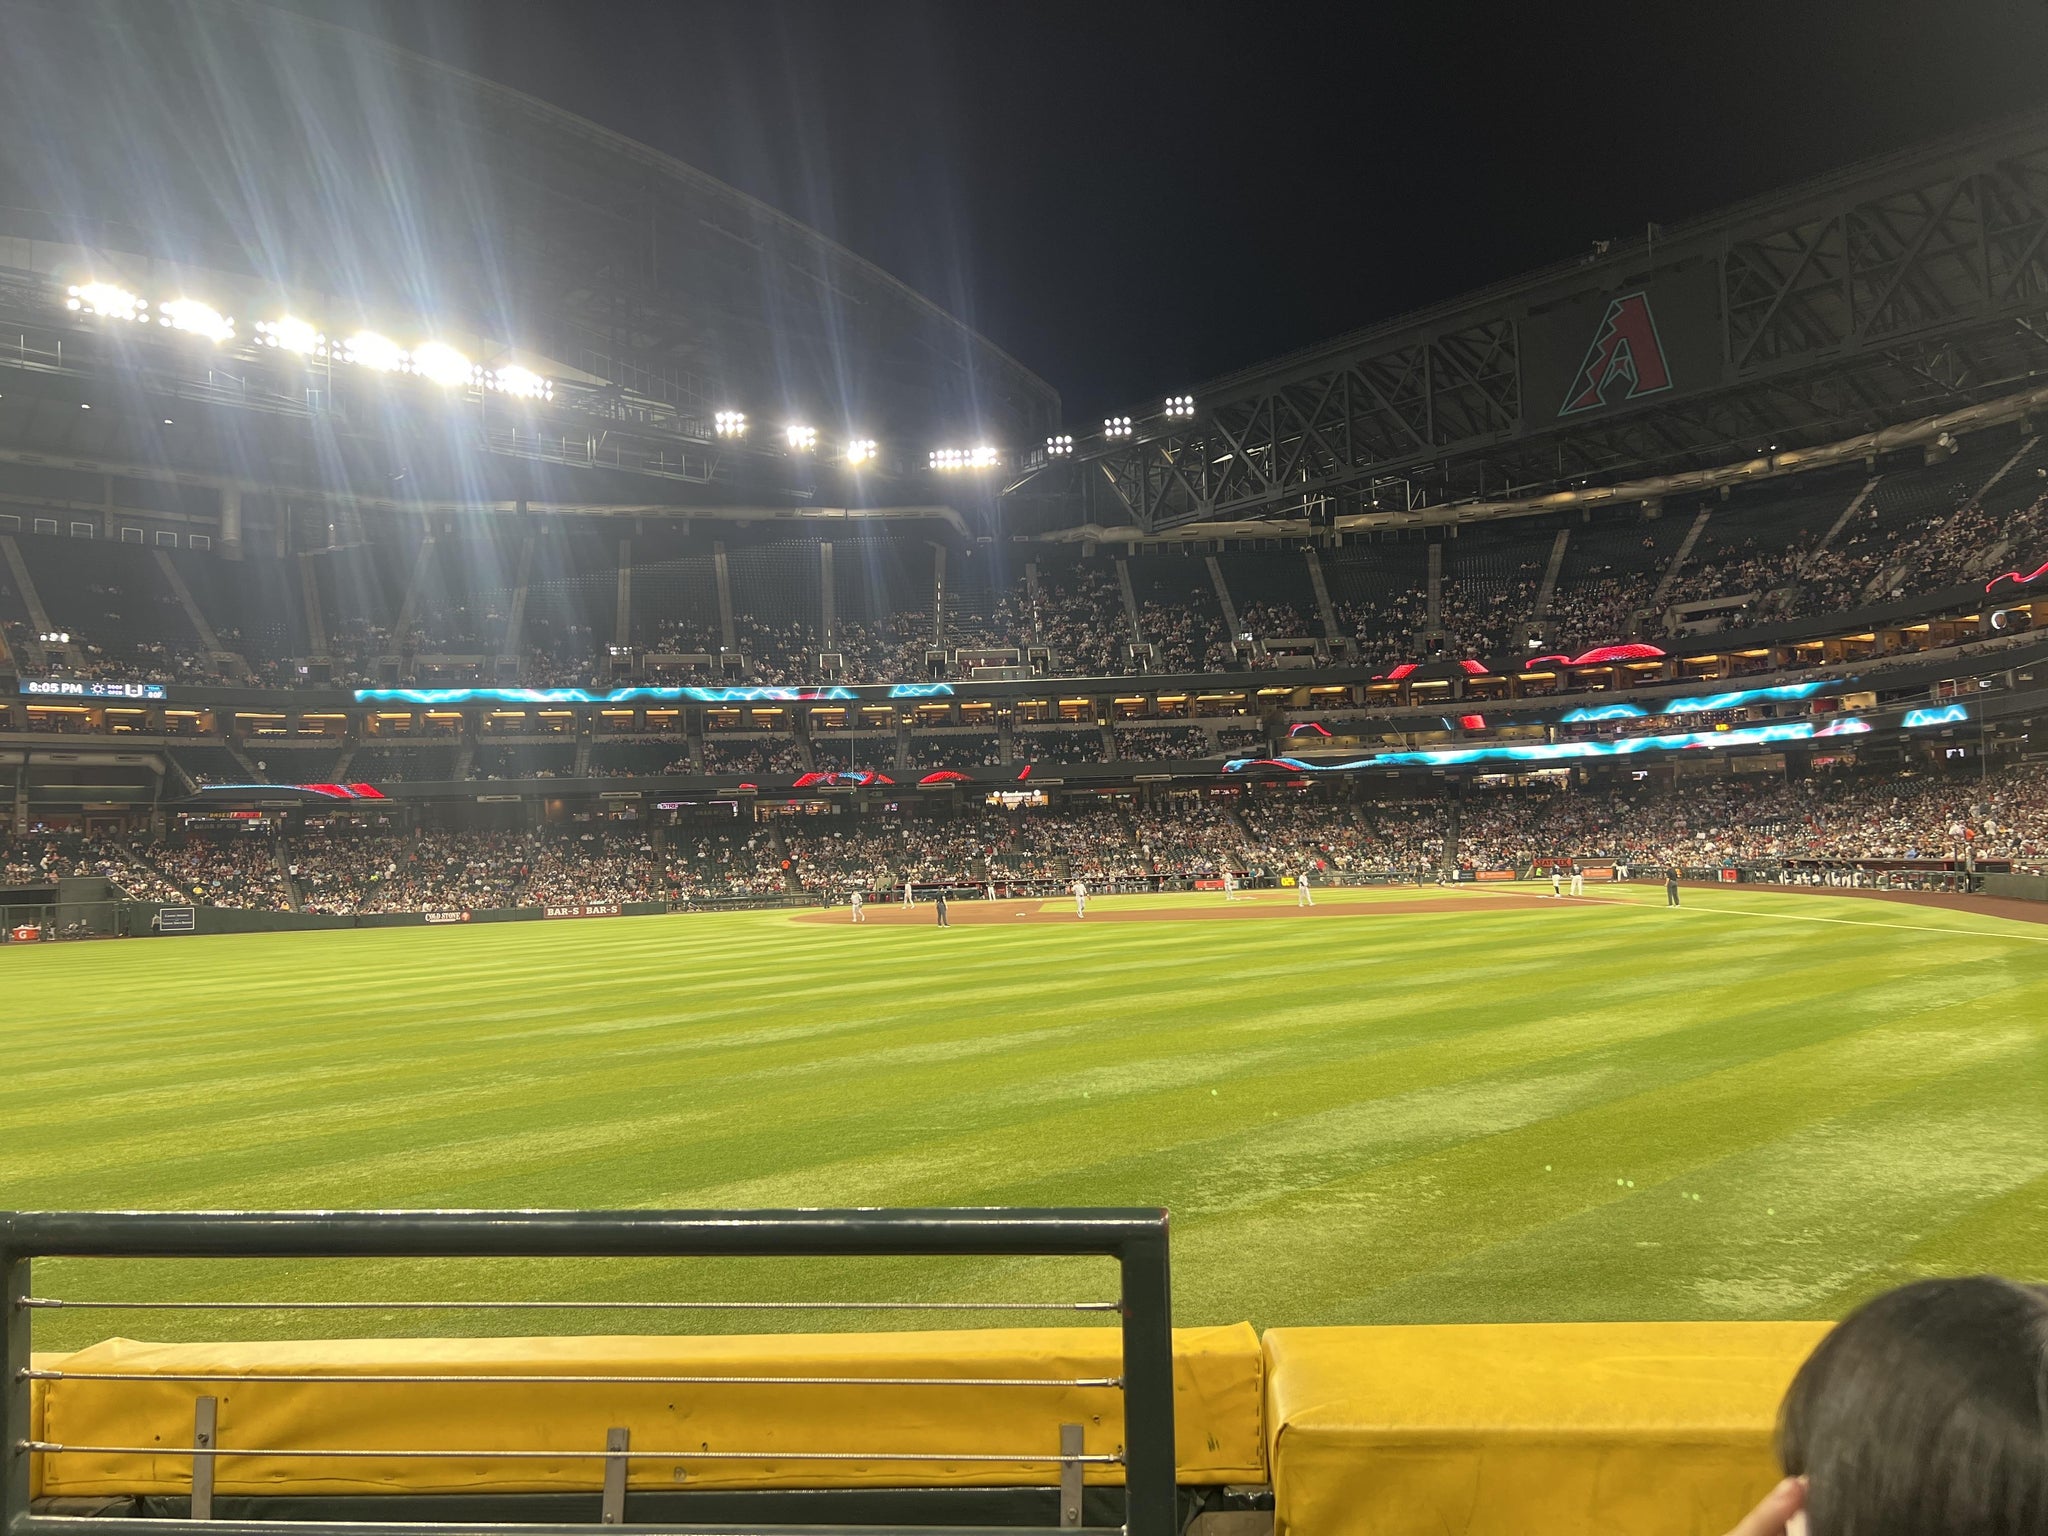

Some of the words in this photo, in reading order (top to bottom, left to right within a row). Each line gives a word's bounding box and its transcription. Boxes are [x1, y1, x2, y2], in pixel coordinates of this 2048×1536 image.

[28, 681, 59, 693] 8:05
[61, 682, 83, 694] PM
[547, 907, 579, 916] BAR-S
[586, 905, 618, 914] BAR-S
[425, 913, 441, 922] COLD
[441, 912, 461, 920] STONE
[18, 930, 27, 939] G
